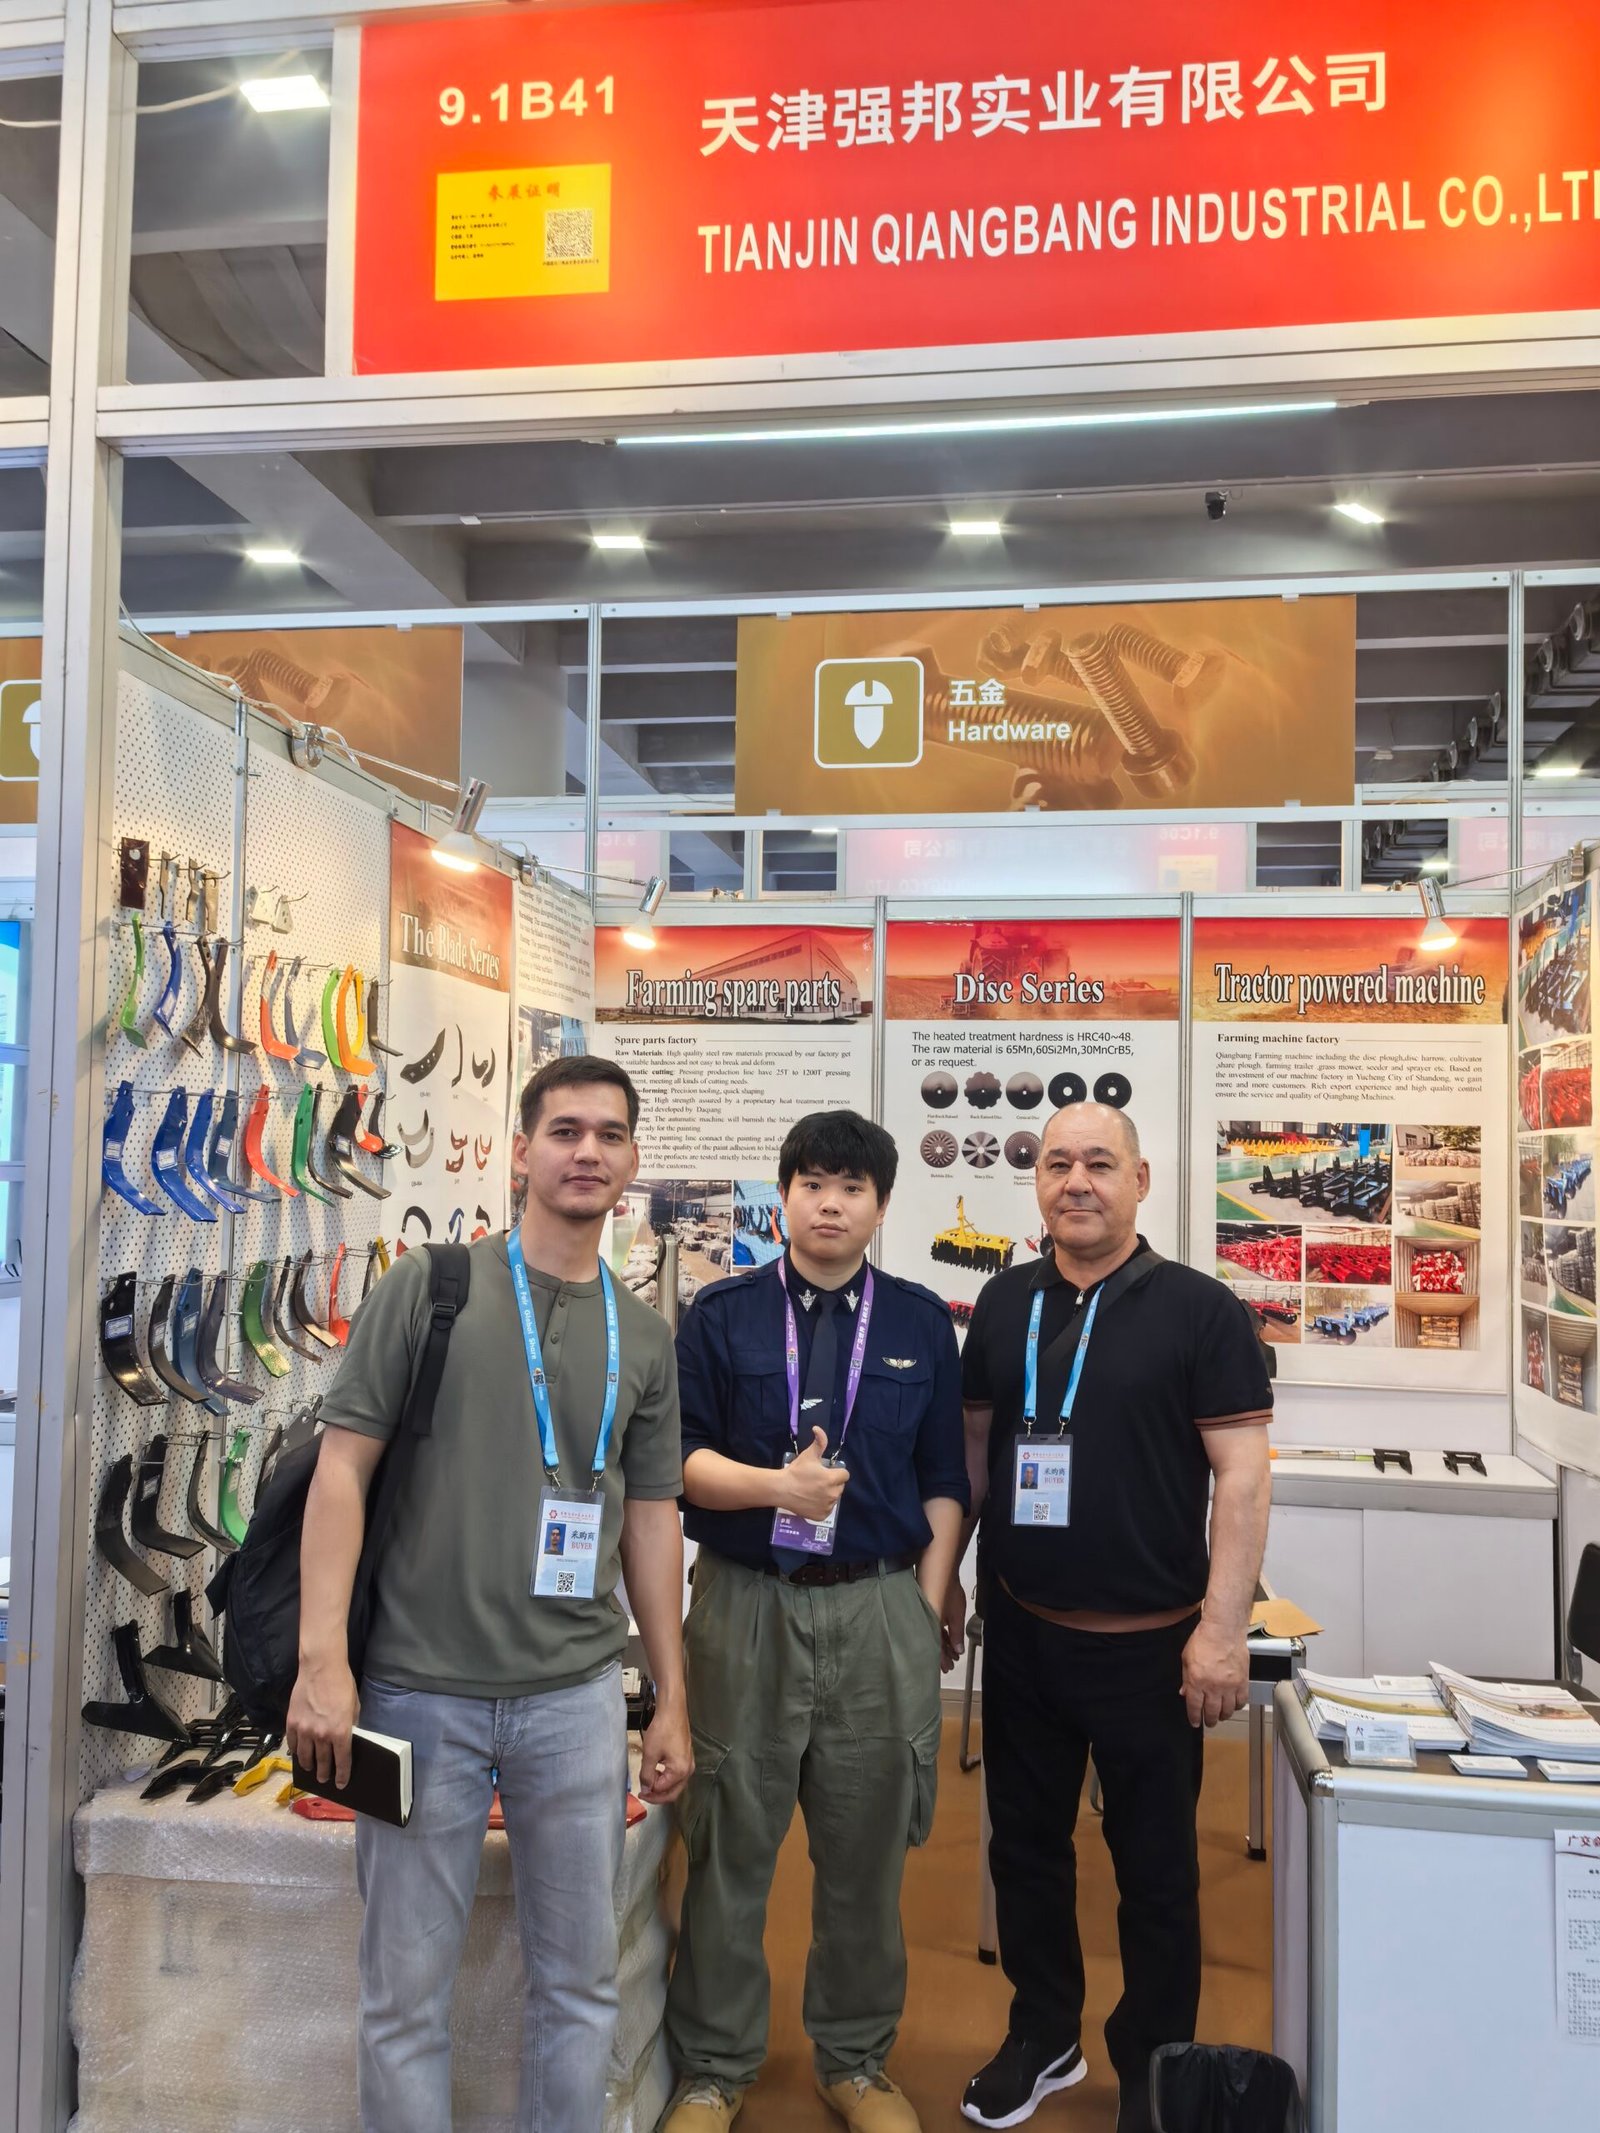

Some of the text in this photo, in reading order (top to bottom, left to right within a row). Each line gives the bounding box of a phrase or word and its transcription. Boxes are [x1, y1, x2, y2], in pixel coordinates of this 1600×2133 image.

[437, 75, 616, 126] 9.1B41
[699, 50, 1388, 158] 天津强邦实业有限公司
[697, 168, 1600, 274] TIANJIN QIANGBANG INDUSTRIAL CO.,LT
[948, 677, 1007, 707] 五金
[947, 717, 1072, 743] Hardware
[400, 912, 500, 981] The Blade Series
[626, 968, 841, 1017] Farming spare parts
[953, 971, 1105, 1004] Disc Series
[1214, 962, 1486, 1015] Tractor powered machine
[614, 1036, 698, 1046] Spare parts factory
[912, 1031, 930, 1042] The
[933, 1031, 966, 1042] heated
[969, 1031, 1016, 1042] treatment
[1019, 1032, 1064, 1042] hardness
[1066, 1032, 1074, 1042] is
[1217, 1033, 1340, 1046] Farming machine factory
[683, 1050, 703, 1058] quality
[912, 1044, 930, 1054] The
[933, 1046, 951, 1054] raw
[953, 1044, 992, 1054] material
[996, 1045, 1004, 1054] is
[1215, 1052, 1252, 1061] Qiangbang
[1254, 1053, 1282, 1061] Farming
[912, 1058, 977, 1068] or as request.
[1266, 1063, 1292, 1071] farming
[571, 1541, 593, 1551] BUYER
